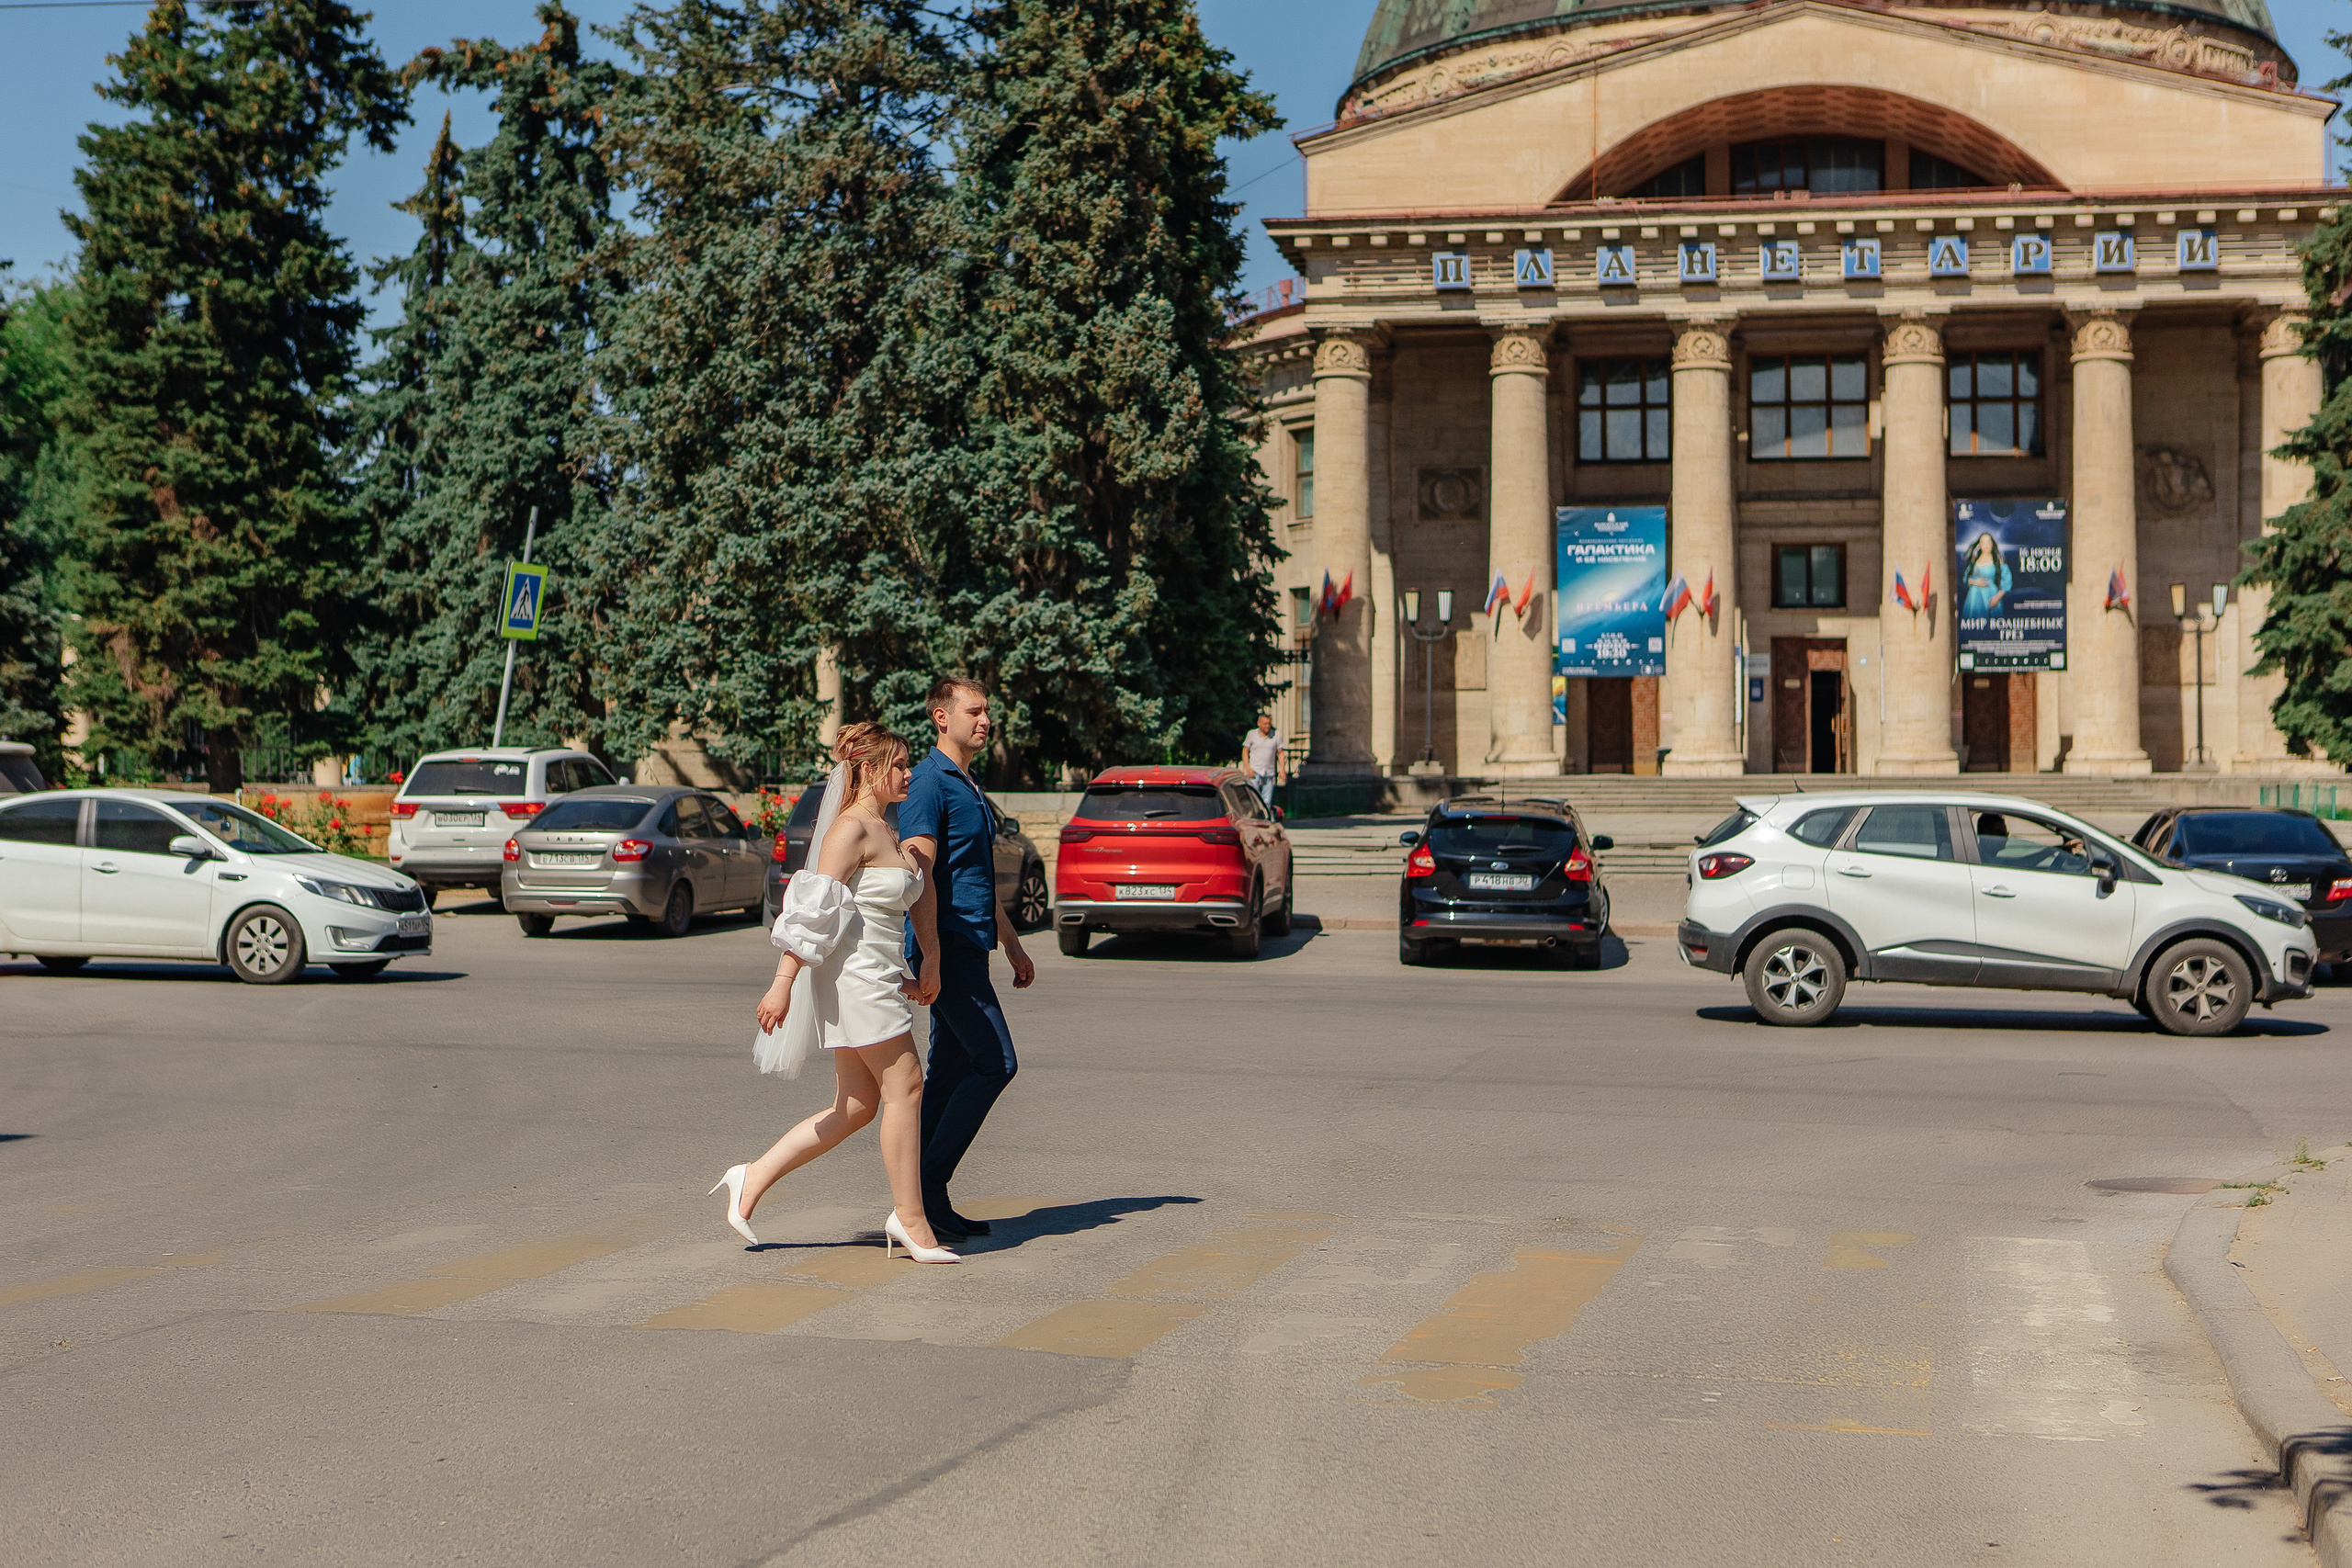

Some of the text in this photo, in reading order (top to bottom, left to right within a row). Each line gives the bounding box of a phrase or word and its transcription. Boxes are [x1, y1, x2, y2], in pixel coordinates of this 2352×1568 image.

[1566, 543, 1656, 557] ГАЛАКТИКА
[2019, 556, 2063, 573] 18:00
[1576, 602, 1648, 612] ПРЕМЬЕРА
[1960, 616, 2064, 630] МИР ВОЛШЕБНЫХ
[1118, 886, 1172, 896] К823ХС 134
